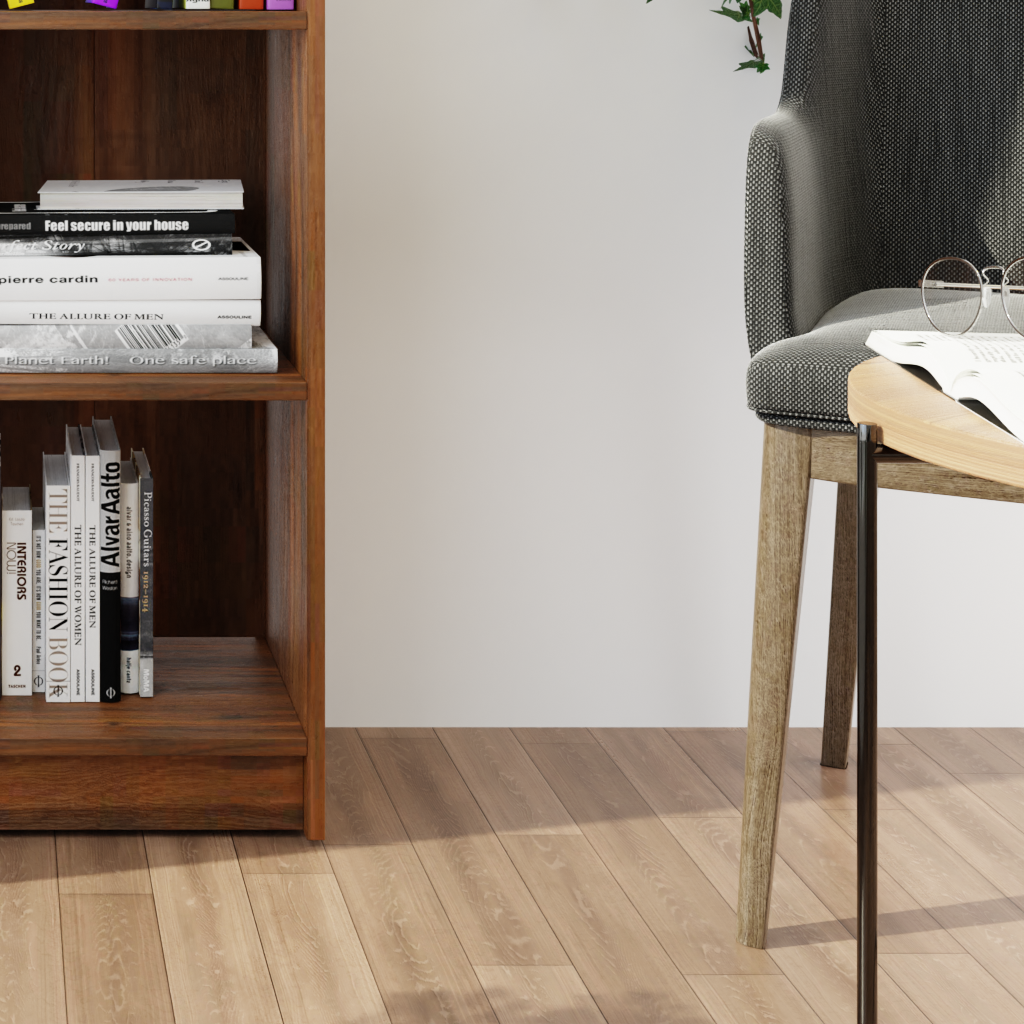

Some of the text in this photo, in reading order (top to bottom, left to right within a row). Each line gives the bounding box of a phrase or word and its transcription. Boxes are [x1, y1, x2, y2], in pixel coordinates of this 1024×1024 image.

[44, 220, 190, 233] Feel secure in your house
[42, 240, 86, 254] Story
[50, 274, 99, 284] cardin
[29, 312, 57, 320] THE
[59, 312, 111, 320] ALLURE
[4, 355, 56, 366] Planet
[60, 355, 110, 366] Earth!
[129, 355, 258, 367] One safe place
[143, 492, 153, 527] Picasso
[143, 528, 153, 567] Guitars
[6, 542, 17, 575] NOW!
[16, 542, 27, 601] INTERIORS
[125, 559, 133, 579] design
[48, 488, 69, 698] THE FASHION BOOK
[74, 525, 82, 646] THE ALLURE OF WOMEN
[89, 590, 96, 605] OF
[13, 665, 21, 677] 2
